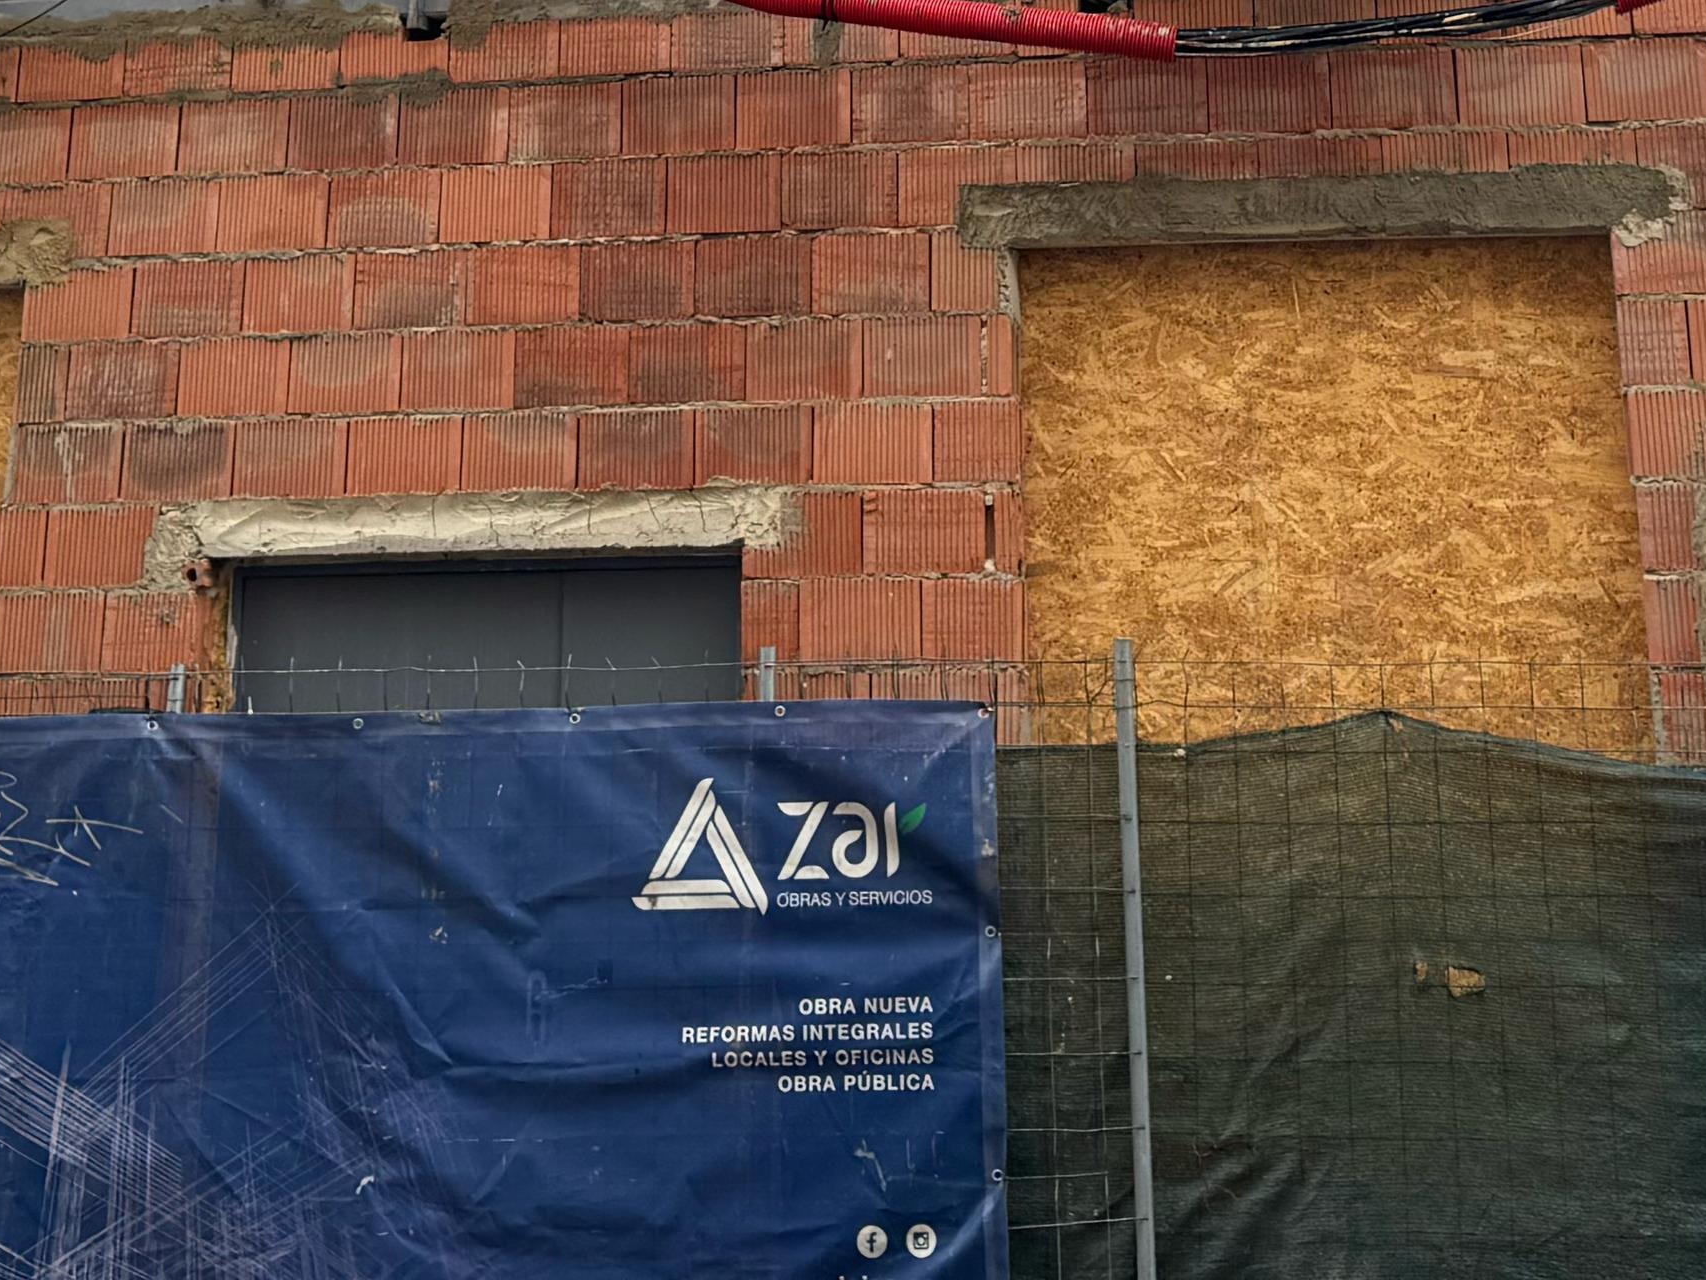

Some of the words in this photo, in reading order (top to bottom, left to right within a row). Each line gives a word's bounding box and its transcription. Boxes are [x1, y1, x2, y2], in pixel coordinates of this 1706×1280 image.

[776, 891, 831, 908] OBRAS
[835, 892, 847, 906] Y
[848, 890, 933, 906] SERVICIOS
[798, 997, 856, 1016] OBRA
[864, 996, 934, 1014] NUEVA
[681, 1024, 795, 1044] REFORMAS
[802, 1022, 934, 1041] INTEGRALES
[711, 1050, 807, 1068] LOCALES
[814, 1050, 828, 1066] Y
[835, 1047, 935, 1066] OFICINAS
[777, 1075, 837, 1093] OBRA
[843, 1070, 935, 1092] PÚBLICA
